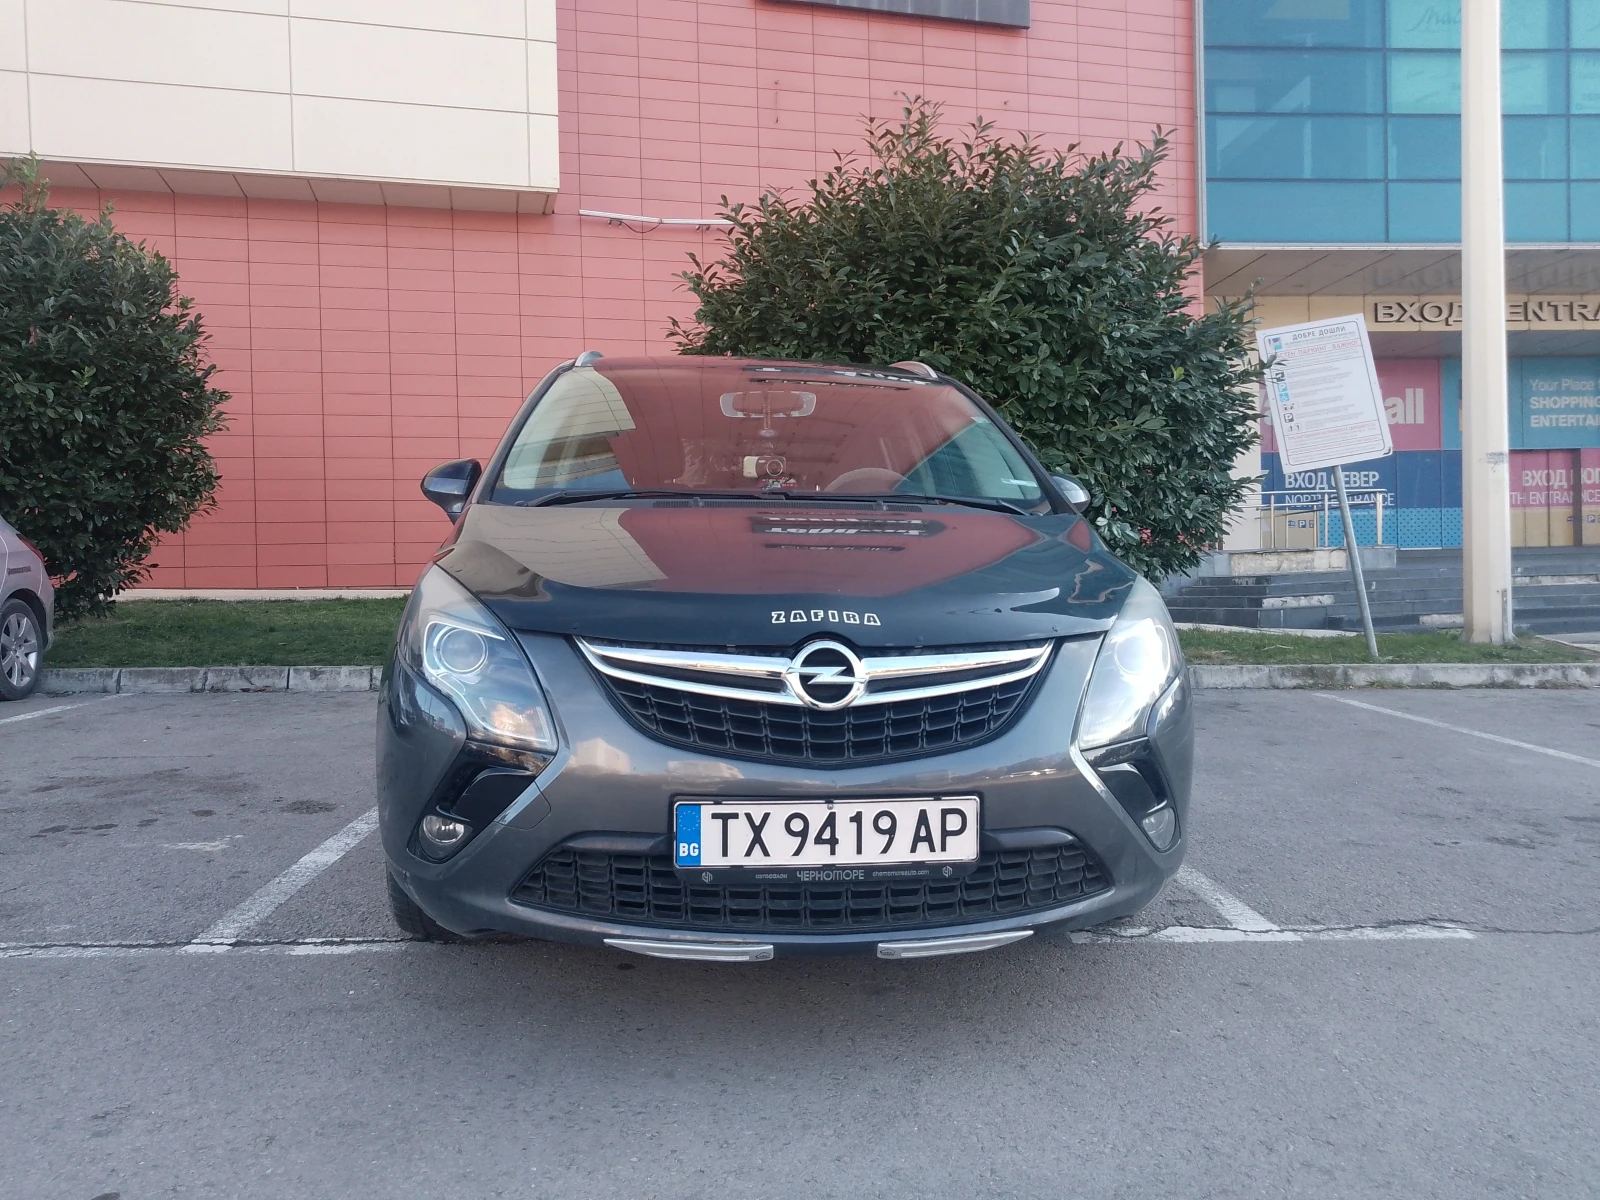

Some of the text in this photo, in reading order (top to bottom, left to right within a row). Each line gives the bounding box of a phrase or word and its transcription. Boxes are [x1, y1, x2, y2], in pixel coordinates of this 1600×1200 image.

[1292, 326, 1346, 341] ДОБРЕ ДОШЛИ
[1529, 379, 1559, 391] Your
[1561, 378, 1596, 391] Place
[1383, 388, 1425, 425] all
[1530, 414, 1600, 427] ENTERTAI
[1284, 471, 1329, 490] ВХОД
[1522, 469, 1568, 489] ВХОД
[771, 609, 881, 626] ZAFIRA
[784, 809, 898, 857] 9419
[679, 842, 699, 857] BG
[796, 869, 865, 882] ЧЕРНОМОРЕ
